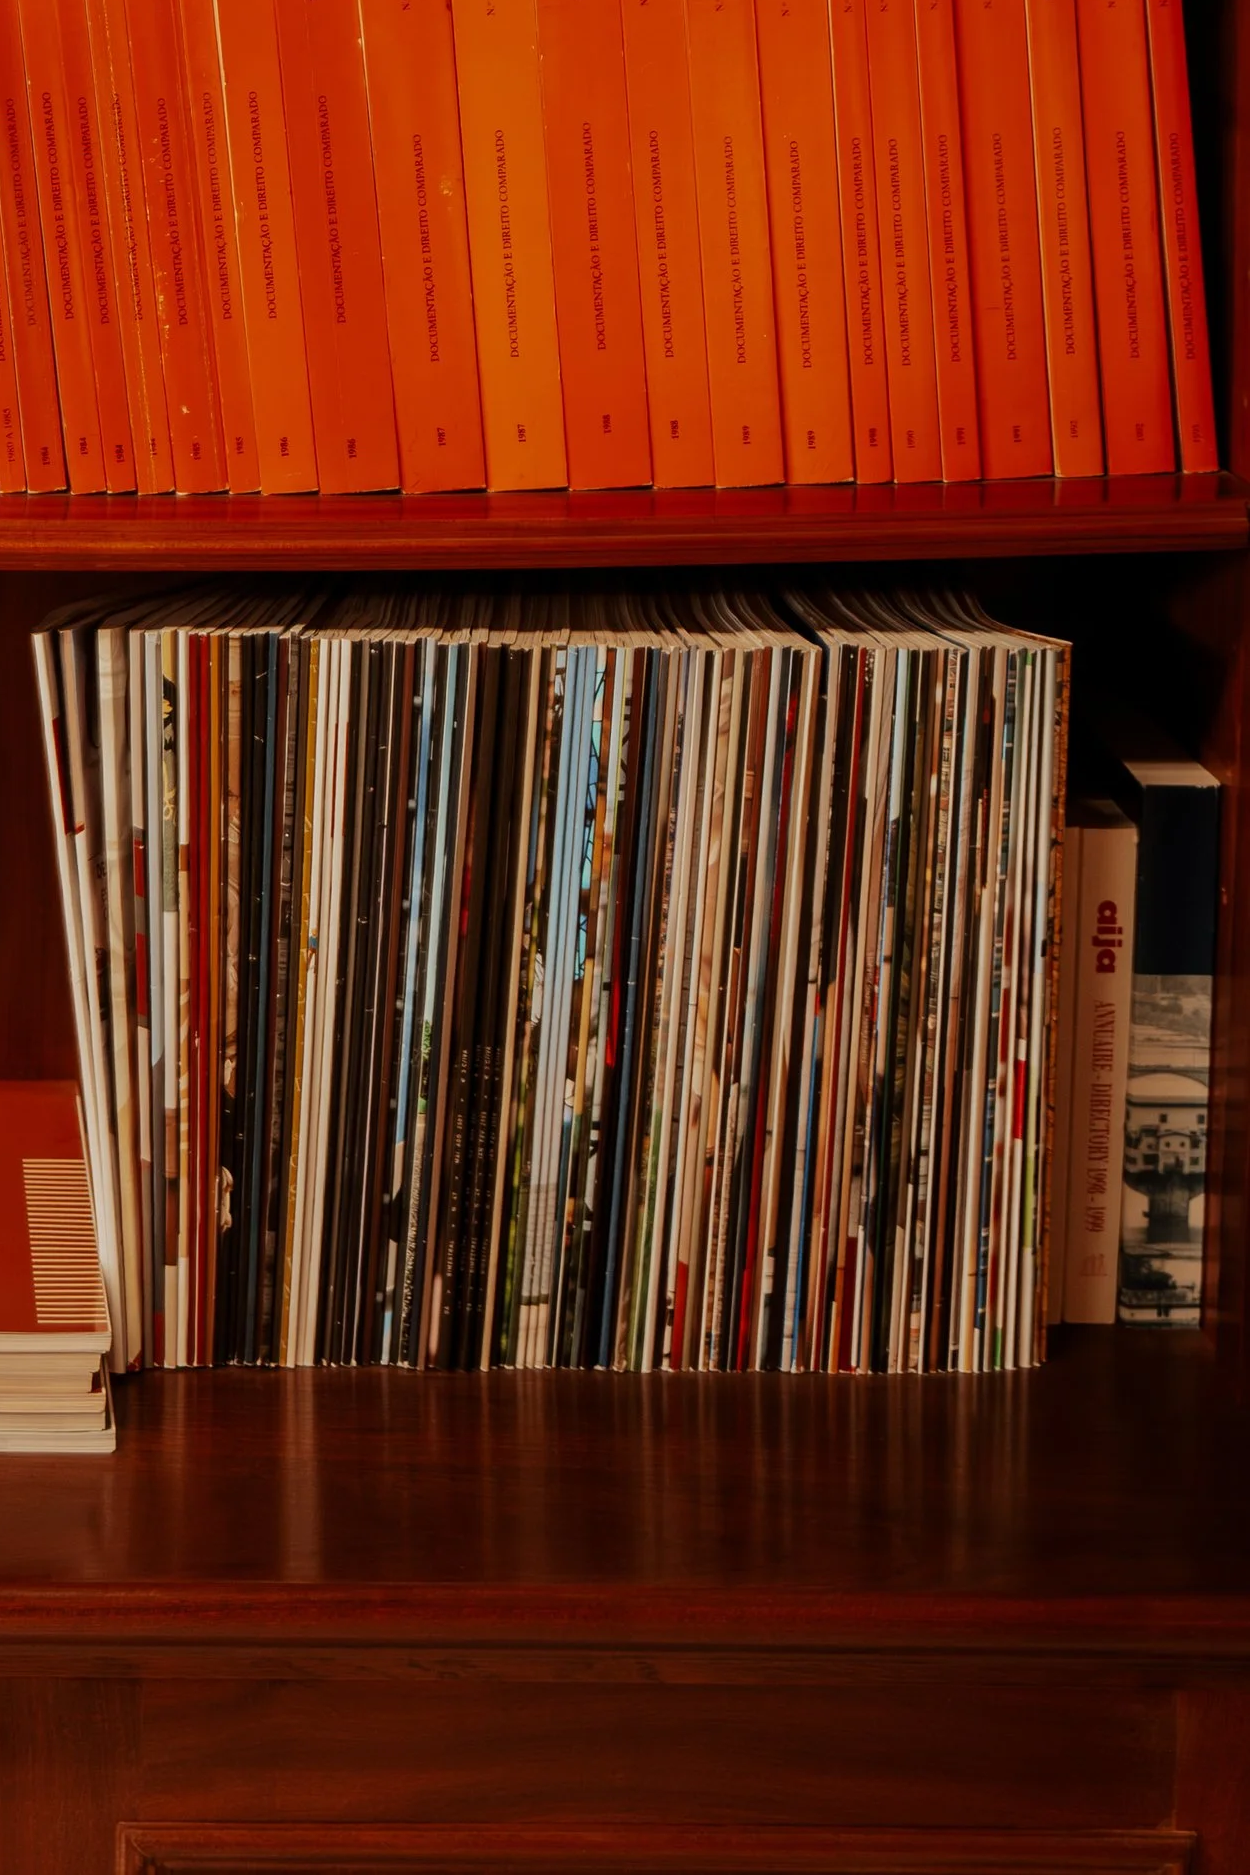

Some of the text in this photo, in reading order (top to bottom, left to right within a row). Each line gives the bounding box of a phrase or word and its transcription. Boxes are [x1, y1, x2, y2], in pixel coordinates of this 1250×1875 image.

[41, 91, 74, 320] DOCUMENTAÇÃO E DIREITO COMPARADO
[248, 90, 277, 319] DOCUMENTAÇÃO E DIREITO COMPARADO
[494, 129, 519, 358] DOCUMENTAÇÃO E DIREITO COMPARADO
[789, 140, 812, 368] DOCUMENTAÇÃO E DIREITO COMPARADO
[78, 436, 88, 455] 1984
[279, 436, 289, 457] 1986
[516, 423, 527, 443] 1987
[806, 429, 816, 449] 1989
[1092, 900, 1123, 974] aija
[1092, 1000, 1116, 1072] ANNUAIRE
[1087, 1084, 1112, 1164] DIRECTORY
[1086, 1168, 1107, 1195] 1998
